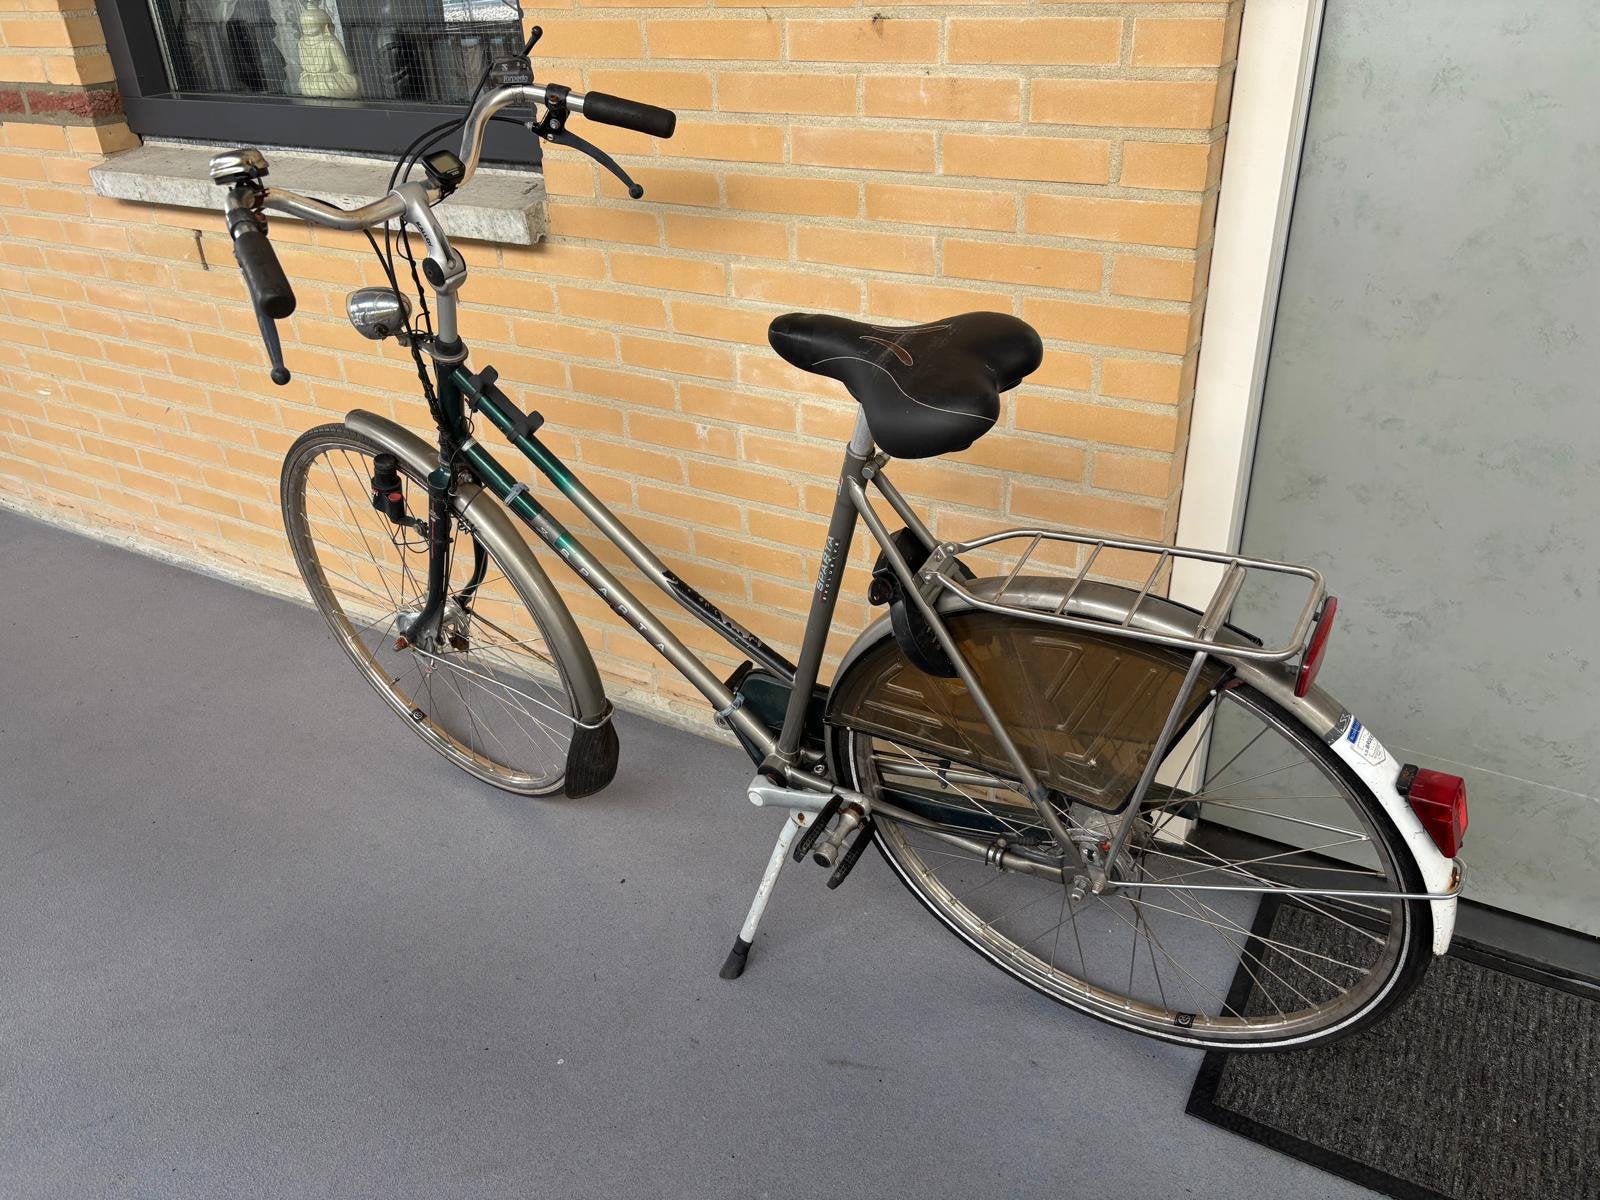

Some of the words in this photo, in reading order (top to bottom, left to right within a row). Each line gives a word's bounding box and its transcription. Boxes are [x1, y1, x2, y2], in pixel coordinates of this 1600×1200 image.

[416, 221, 434, 247] KALLOY
[816, 535, 834, 592] SPARTA
[559, 547, 667, 653] SPARTA
